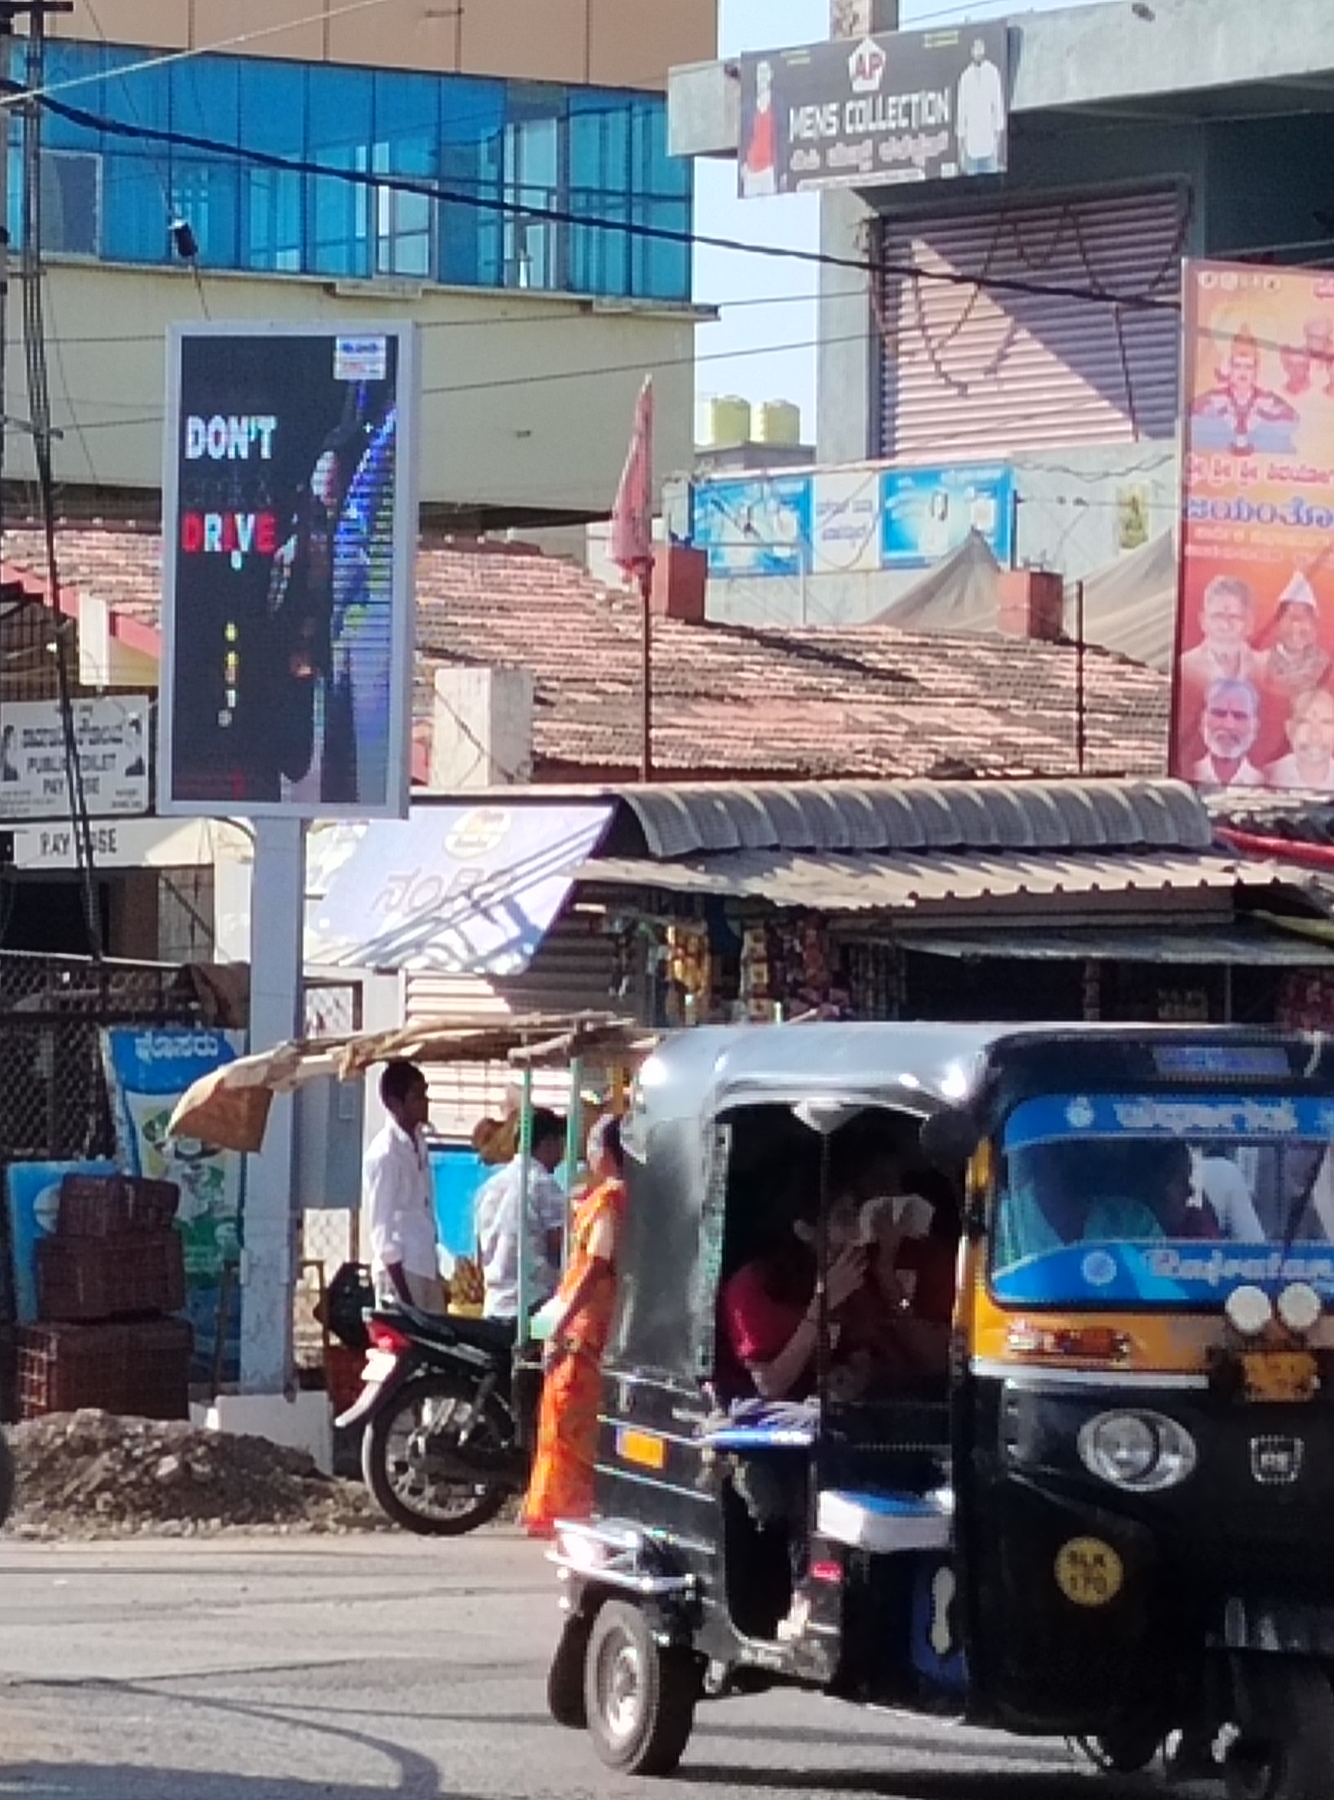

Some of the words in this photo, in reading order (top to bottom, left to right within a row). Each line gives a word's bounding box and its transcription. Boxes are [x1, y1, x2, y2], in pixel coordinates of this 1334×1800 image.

[856, 52, 886, 81] AP
[789, 102, 840, 143] MENS
[845, 87, 951, 134] COLLECTION
[185, 415, 276, 459] DON'T
[182, 512, 276, 555] DRIVE
[40, 831, 70, 856] PAY
